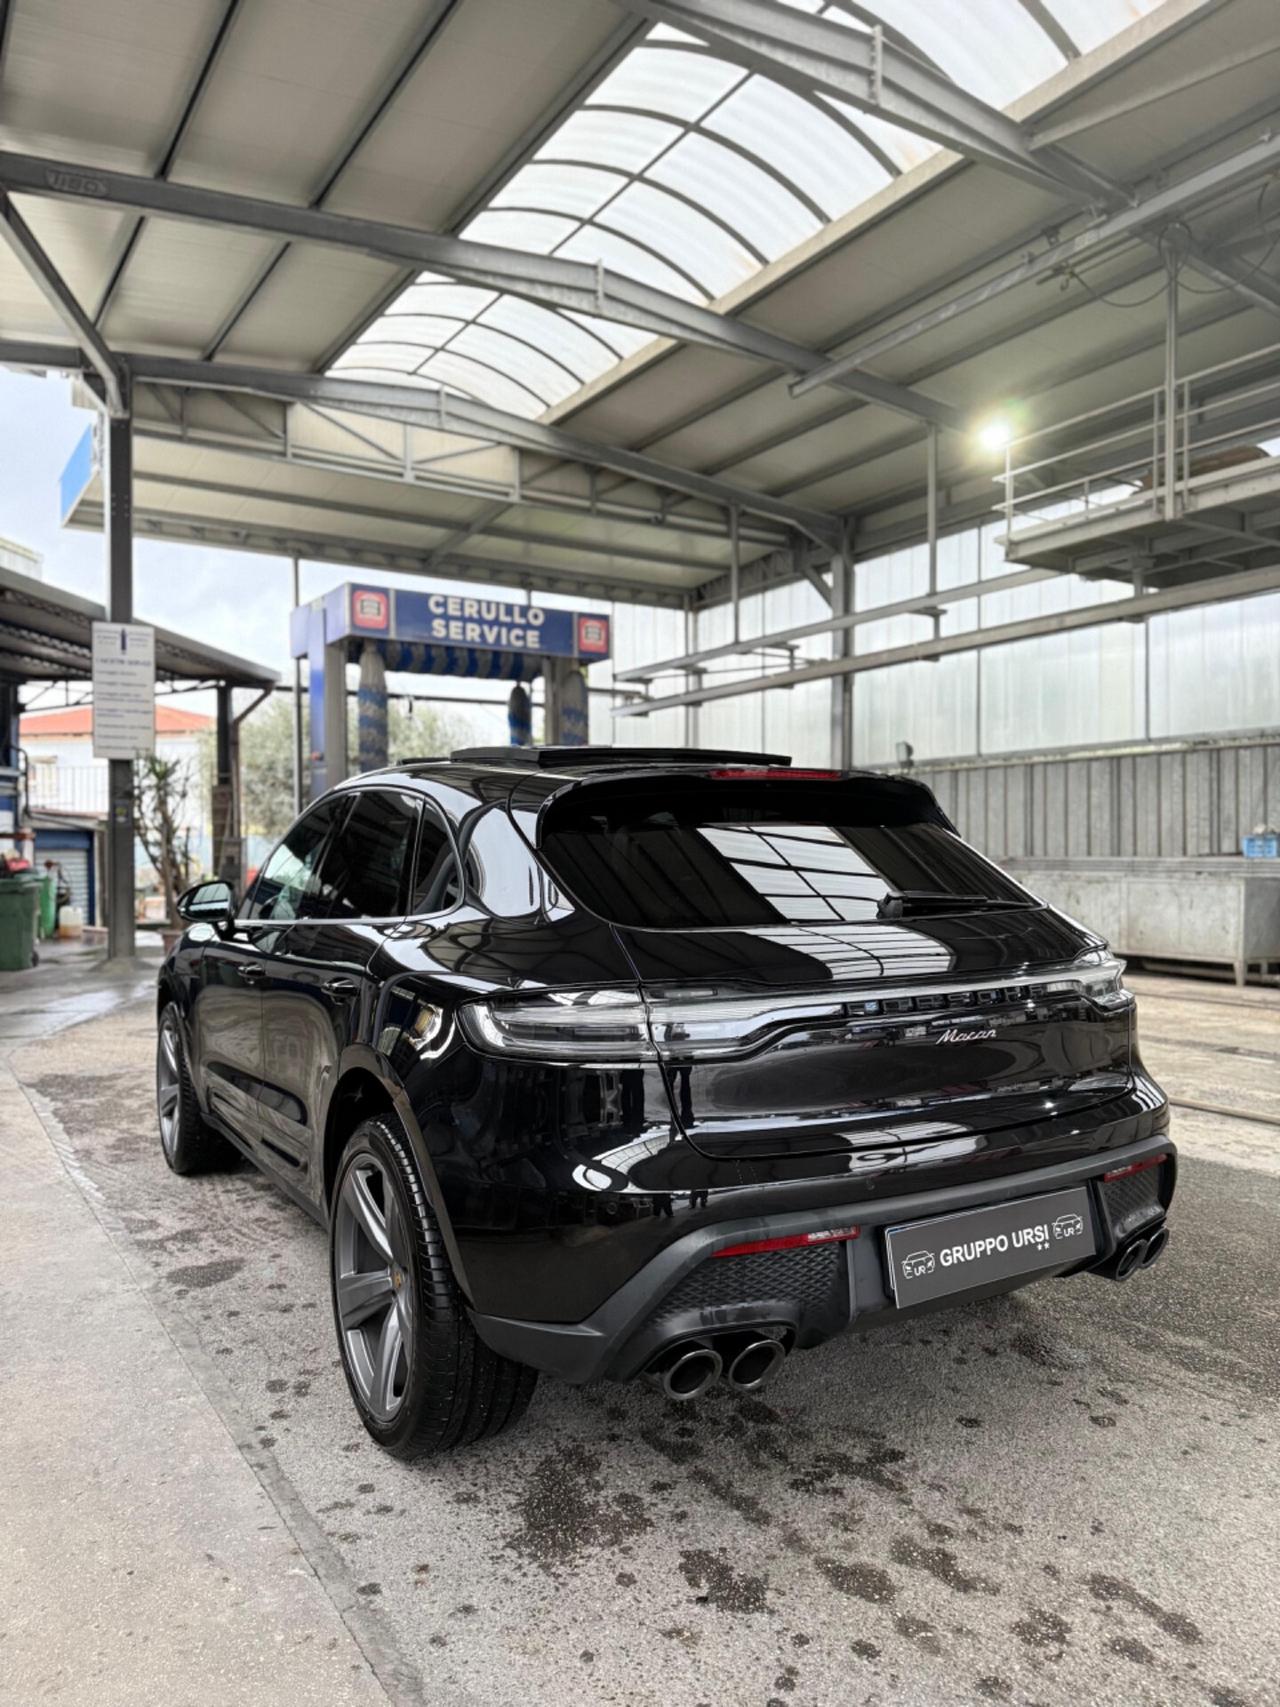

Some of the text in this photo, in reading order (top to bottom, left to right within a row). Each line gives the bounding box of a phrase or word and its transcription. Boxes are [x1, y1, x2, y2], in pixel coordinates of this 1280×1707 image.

[427, 594, 545, 626] CERULLO
[431, 618, 541, 649] SERVICE
[936, 1029, 997, 1045] Macan
[914, 1224, 1075, 1276] UR GRUPPO URSI UR
